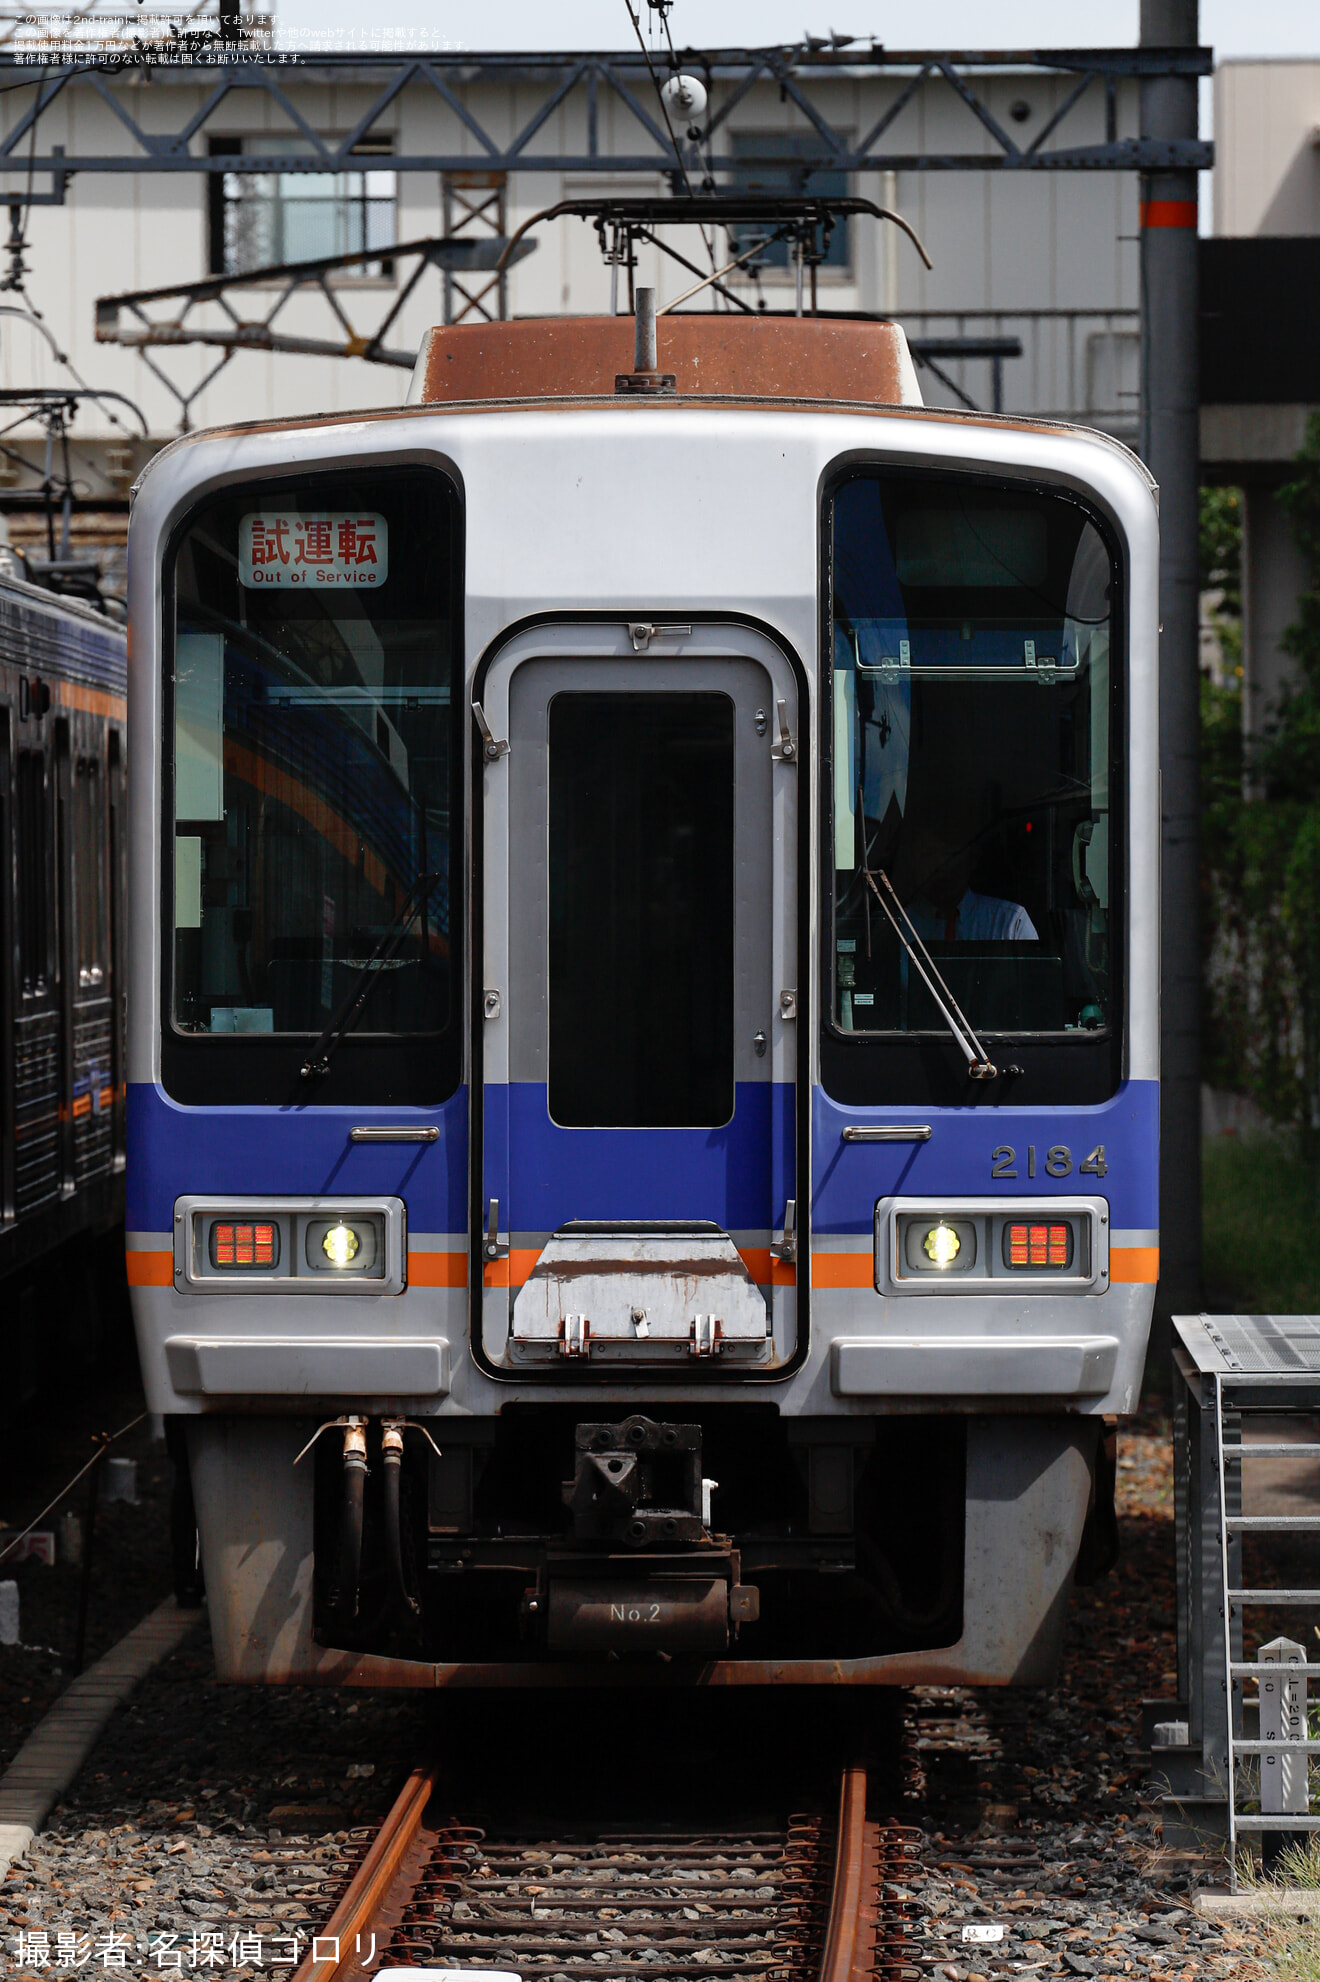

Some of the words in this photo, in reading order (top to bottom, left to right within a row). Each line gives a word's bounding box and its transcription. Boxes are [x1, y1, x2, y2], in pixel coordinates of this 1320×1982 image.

[251, 518, 378, 565] 試運転
[253, 570, 282, 583] Out
[291, 569, 307, 582] of
[316, 569, 377, 582] Service
[992, 1145, 1108, 1177] 2184
[610, 1603, 661, 1622] No.2
